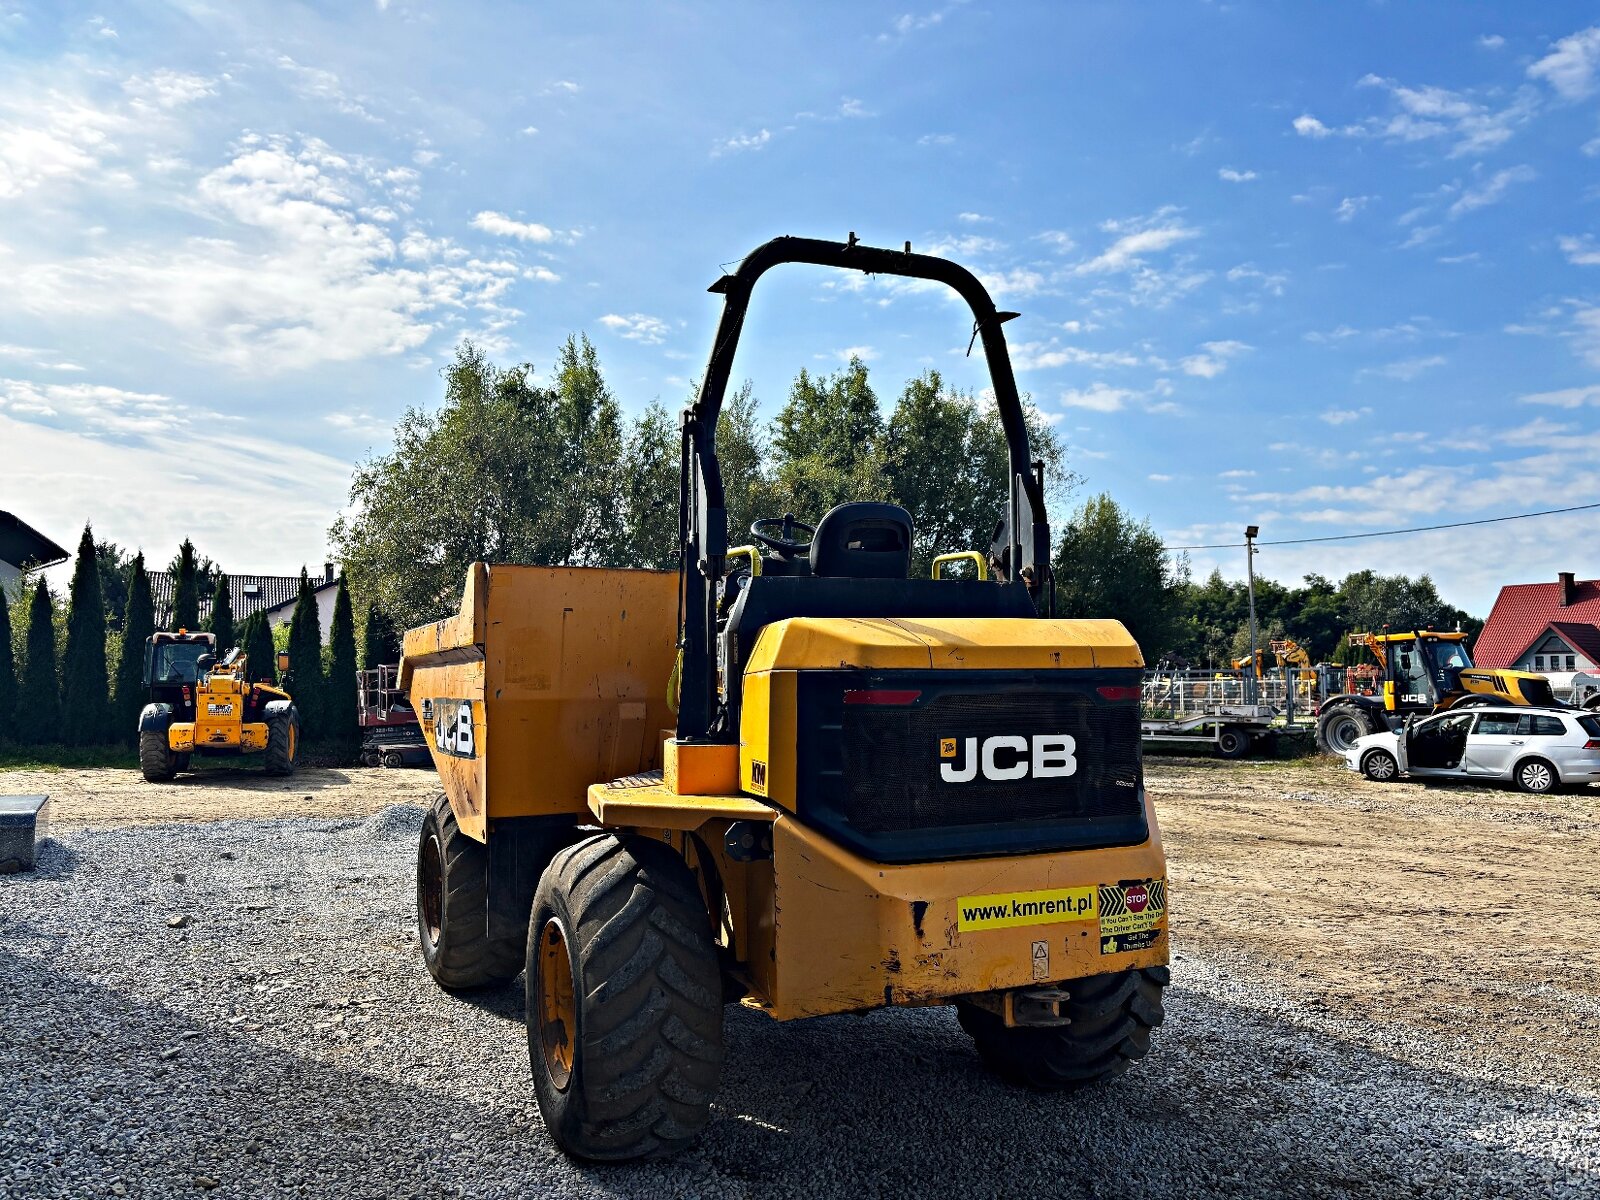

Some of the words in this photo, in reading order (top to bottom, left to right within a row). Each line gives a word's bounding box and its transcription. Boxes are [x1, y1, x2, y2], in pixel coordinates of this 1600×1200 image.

[1401, 694, 1427, 704] JCB
[940, 734, 1077, 783] JCB
[1126, 894, 1147, 904] STOP
[962, 893, 1093, 922] www.kmrent.pl
[1106, 916, 1117, 924] You
[1133, 913, 1144, 921] See
[1144, 912, 1155, 920] The
[1113, 924, 1132, 933] Driver
[1132, 922, 1148, 930] Can't
[1127, 933, 1138, 941] Get
[1139, 931, 1149, 940] The
[1123, 941, 1145, 950] Thumbs
